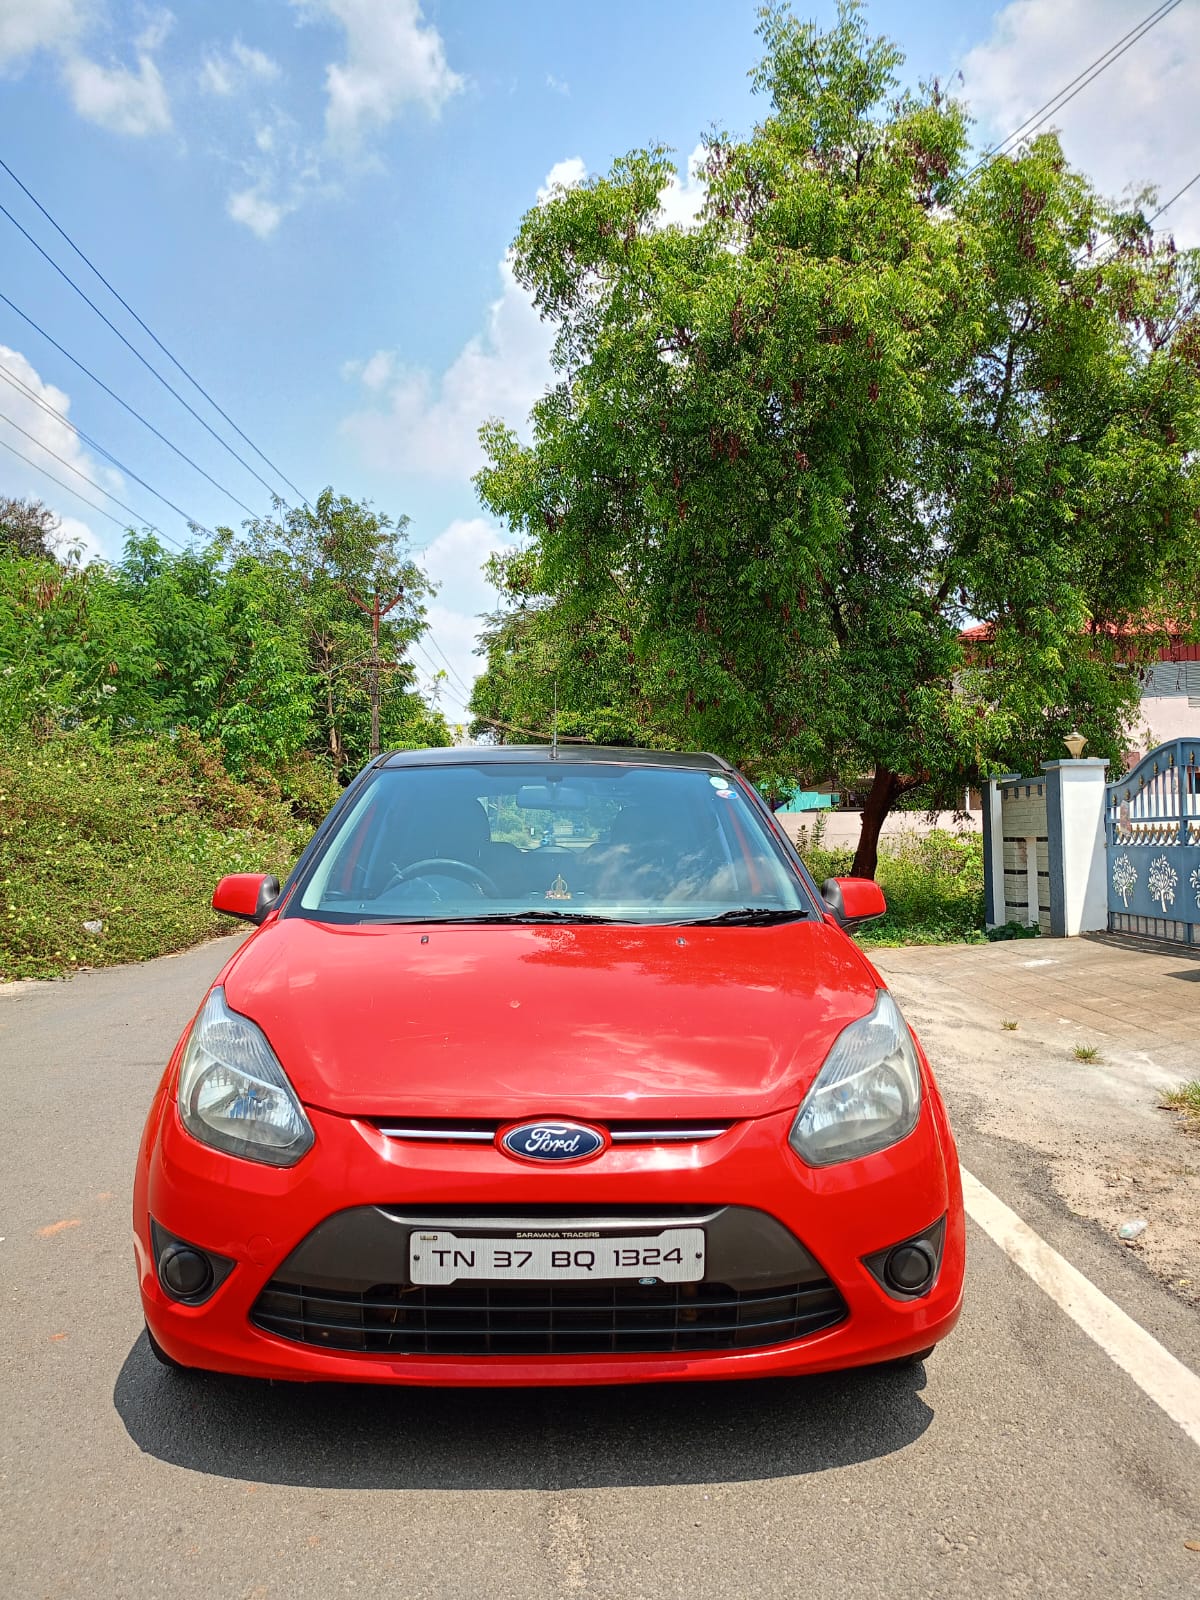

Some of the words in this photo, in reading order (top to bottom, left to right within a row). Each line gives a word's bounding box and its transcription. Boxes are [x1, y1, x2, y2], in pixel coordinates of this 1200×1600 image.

[525, 1128, 581, 1152] Ford
[432, 1250, 475, 1267] TN
[494, 1251, 533, 1268] 37
[552, 1251, 595, 1271] BQ
[613, 1248, 683, 1267] 1324
